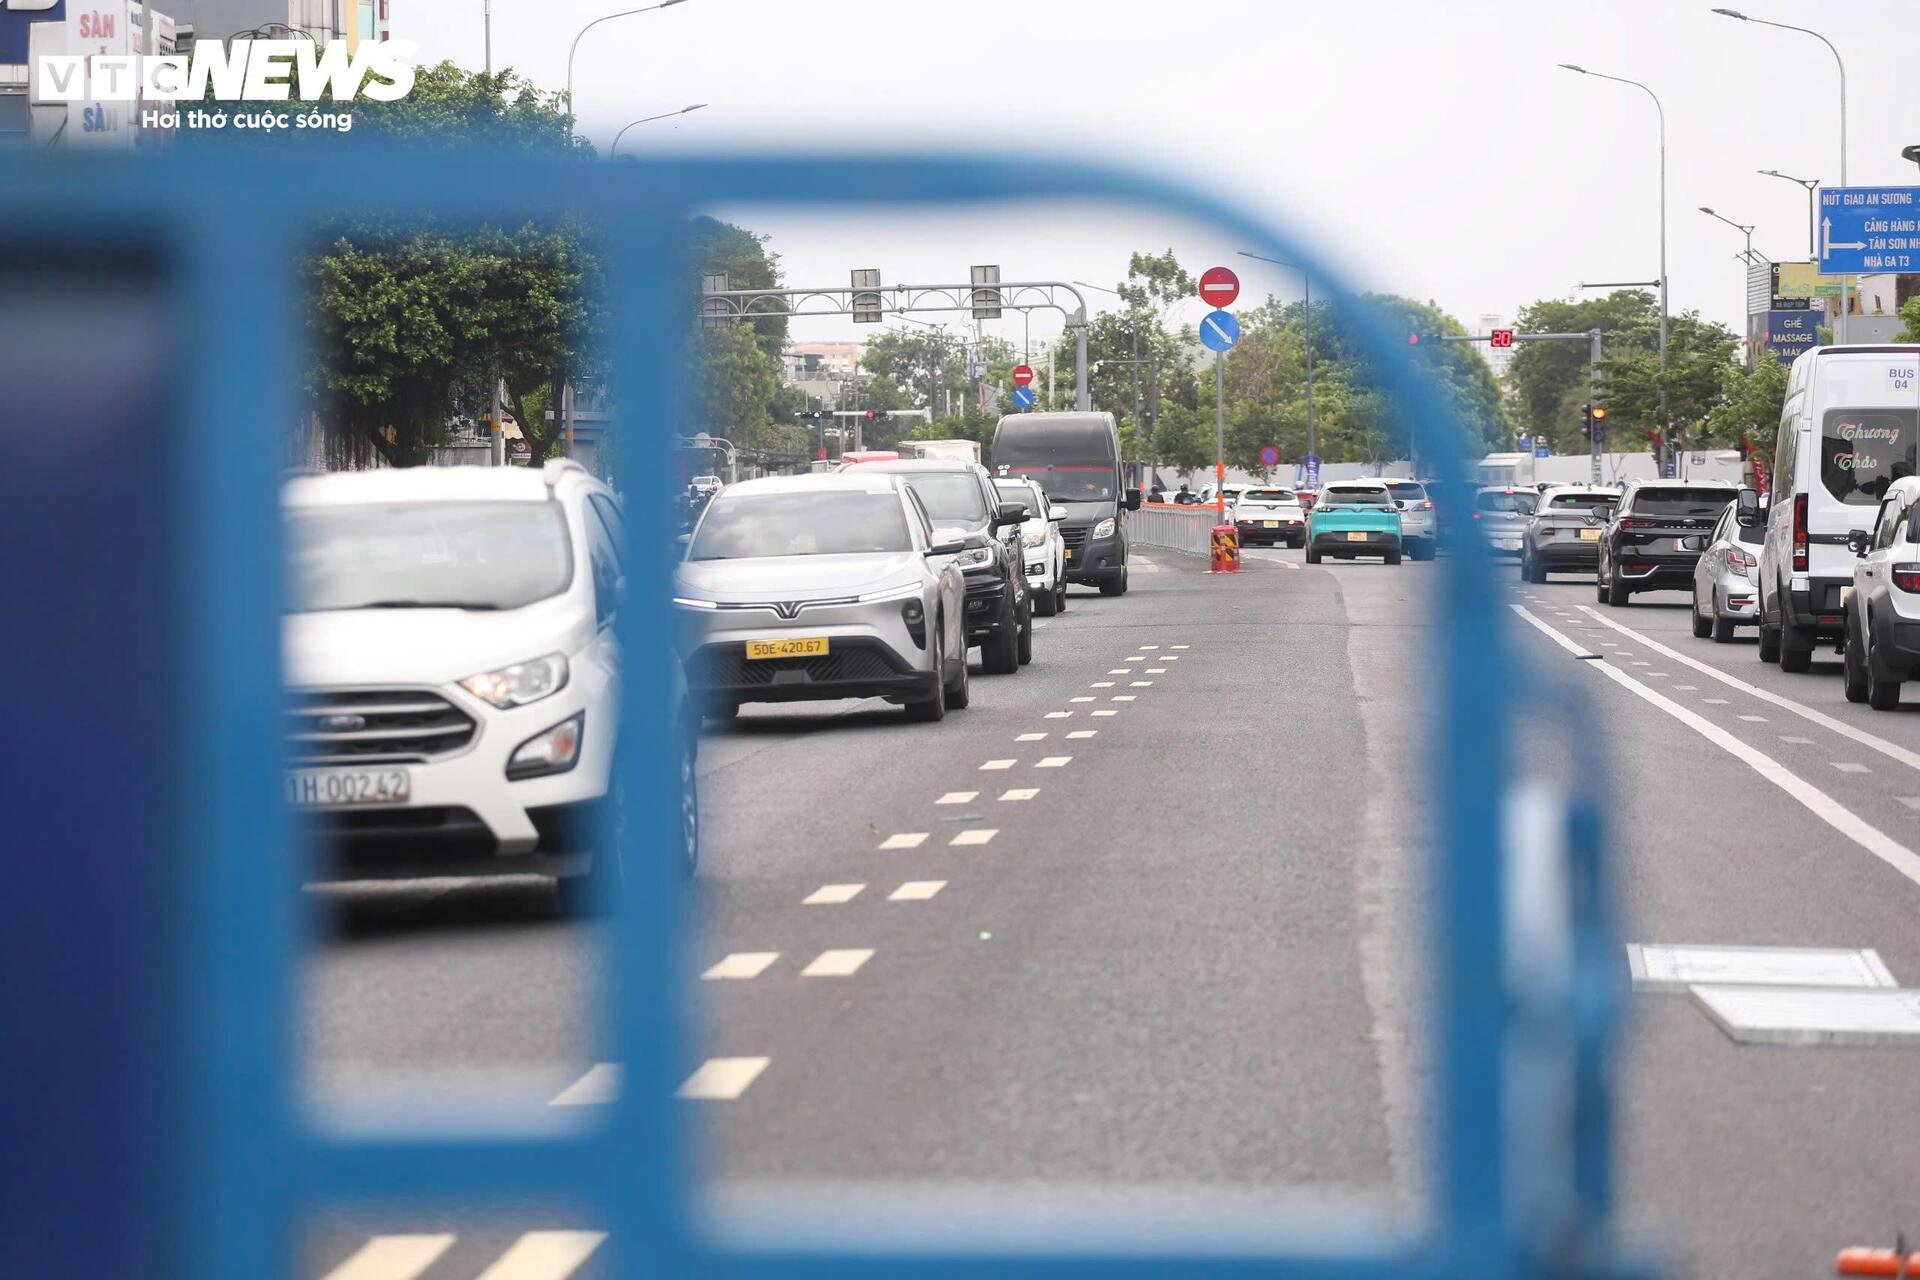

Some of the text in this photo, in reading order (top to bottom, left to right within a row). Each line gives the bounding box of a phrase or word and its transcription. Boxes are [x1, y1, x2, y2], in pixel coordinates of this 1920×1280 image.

[1823, 190, 1841, 206] NÚT
[1843, 193, 1864, 206] GIAO
[1866, 193, 1879, 205] AN
[1890, 217, 1915, 232] HÀNG
[1868, 235, 1886, 250] TÂN
[1909, 238, 1920, 250] NH
[1864, 252, 1910, 268] NHÀ GA T3
[1492, 331, 1511, 346] 20
[1772, 333, 1814, 343] MASSAGE
[1889, 368, 1914, 379] BUS
[1894, 379, 1908, 390] 04
[753, 640, 822, 656] 50E-420.67
